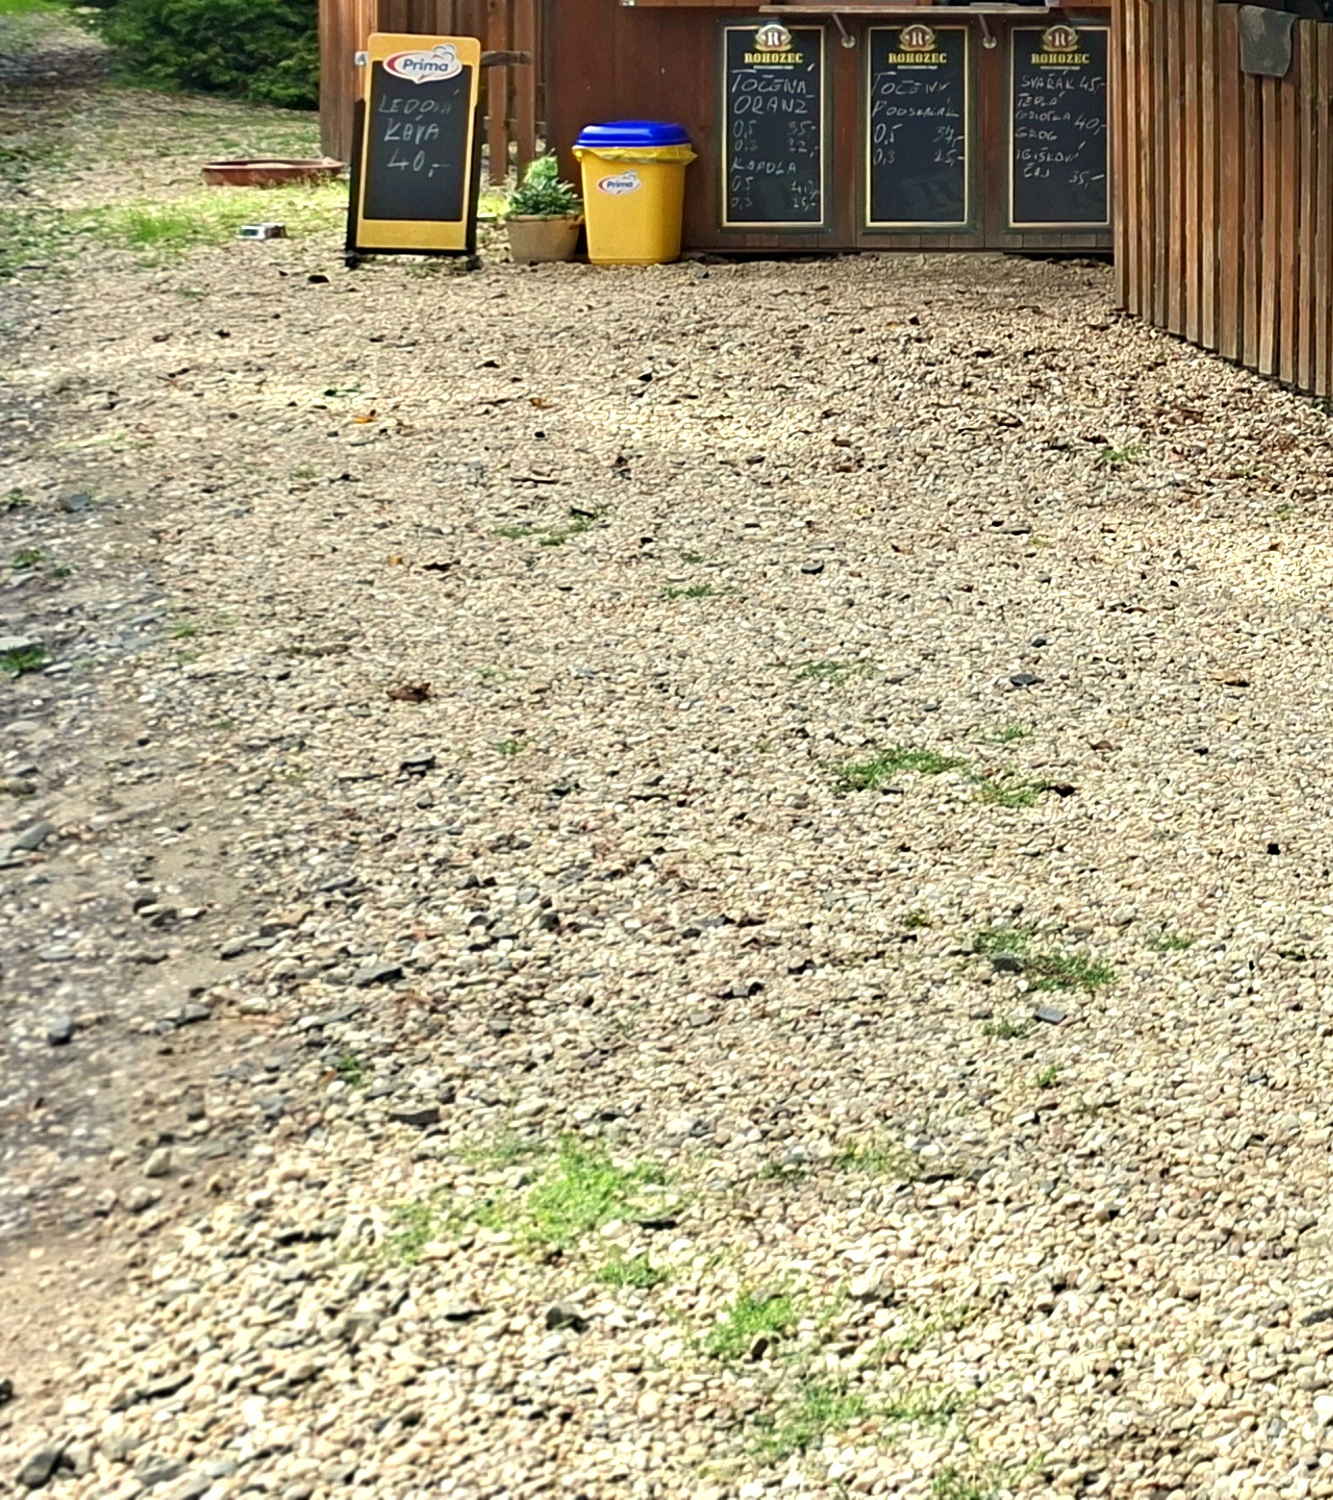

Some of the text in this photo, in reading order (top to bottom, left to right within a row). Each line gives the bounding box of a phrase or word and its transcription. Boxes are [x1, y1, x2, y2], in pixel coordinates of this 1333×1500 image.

[402, 58, 449, 72] Prima
[744, 52, 804, 64] ROHOZEC
[888, 52, 948, 64] ROHOZEC
[1030, 52, 1090, 65] ROHOZEC
[732, 120, 758, 140] 0,5
[1074, 112, 1107, 136] 40,-
[873, 123, 903, 145] 0,5
[386, 148, 450, 178] 40,-
[873, 148, 896, 167] 0,3
[1023, 162, 1051, 179] ČAJ
[606, 180, 634, 189] Prima
